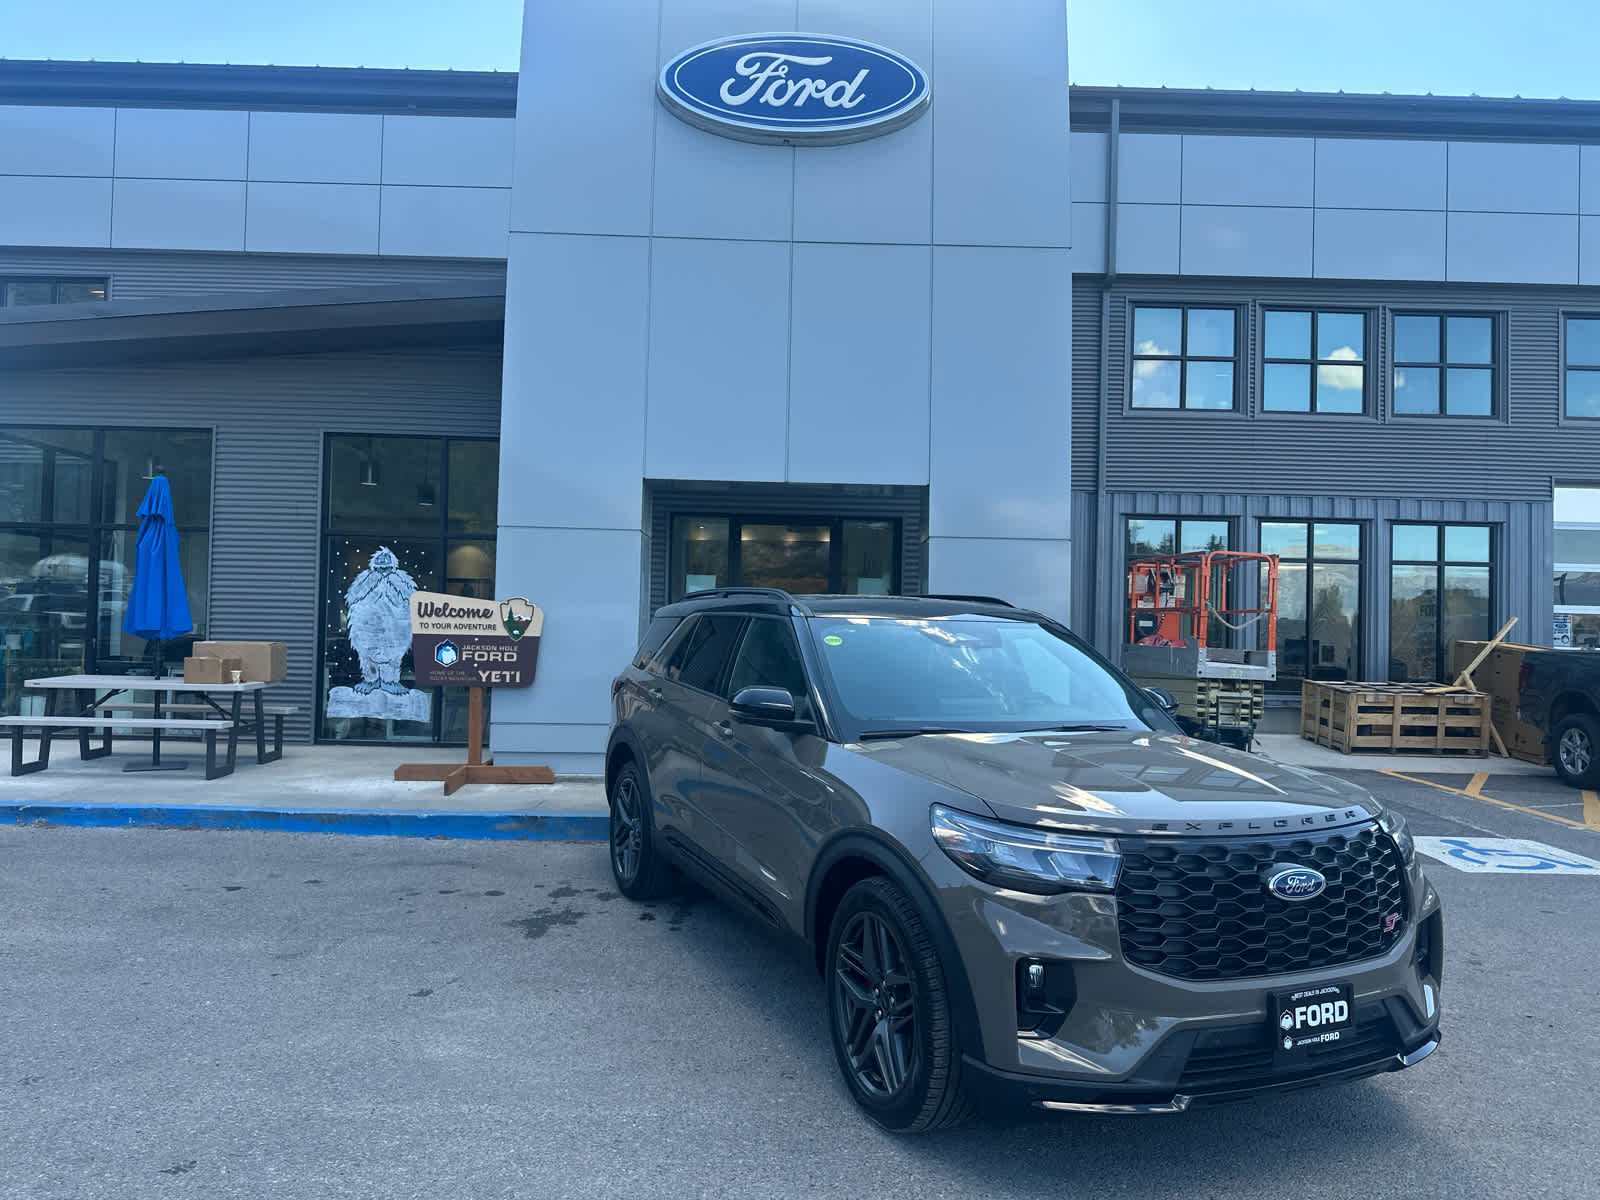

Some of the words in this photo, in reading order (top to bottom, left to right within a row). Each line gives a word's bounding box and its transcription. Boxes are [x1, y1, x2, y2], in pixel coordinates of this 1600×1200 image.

[720, 52, 869, 109] Ford
[417, 602, 494, 619] Welcome
[454, 623, 497, 631] ADVENTURE
[462, 651, 517, 662] FORD
[478, 670, 520, 683] YETI
[1151, 809, 1357, 831] EXPLORER
[1285, 875, 1315, 894] Ford
[1295, 1000, 1348, 1029] FORD
[1321, 1032, 1339, 1043] FORD
